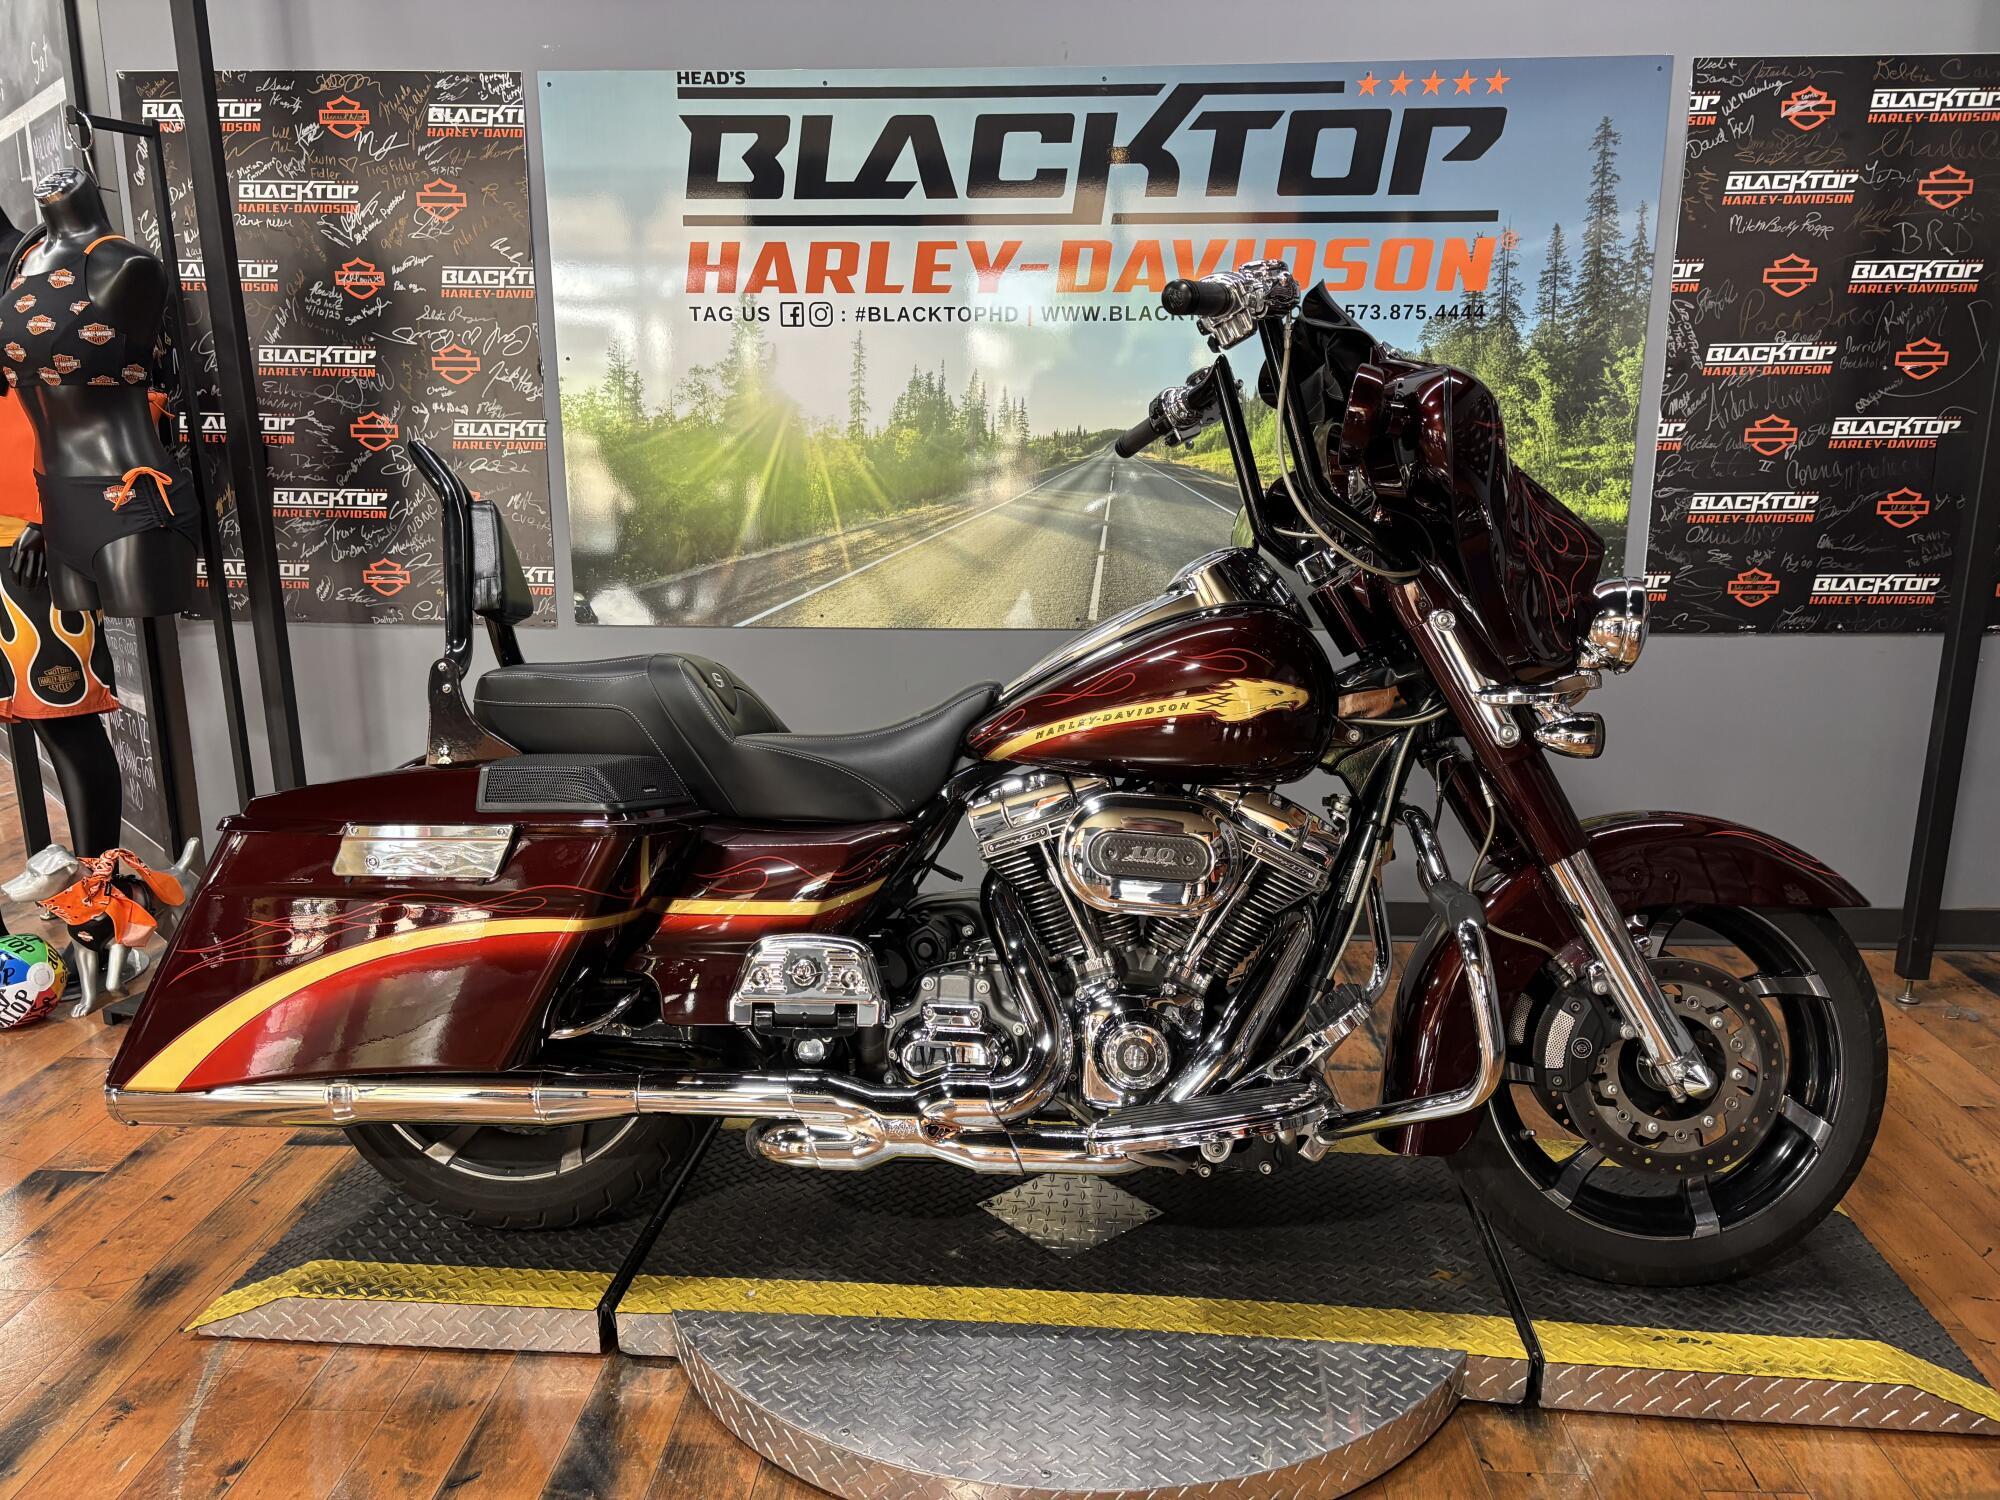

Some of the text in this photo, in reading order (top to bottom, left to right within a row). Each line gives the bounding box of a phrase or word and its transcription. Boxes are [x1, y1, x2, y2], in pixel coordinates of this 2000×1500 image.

[677, 71, 746, 85] HEAD'S
[1870, 90, 2000, 110] BLACKTOP
[142, 101, 262, 119] BLATOP
[428, 106, 524, 125] BLACKT
[679, 98, 1508, 213] BLACKTOP
[1725, 172, 1859, 192] BLACKTOP
[239, 182, 359, 201] BLACKTOP
[1722, 194, 1854, 206] HARLEY-DAVIDSON
[239, 203, 359, 214] HARLEY-DAVIDSON
[685, 236, 1498, 294] HARLEY-DAVIDSON
[1851, 262, 1984, 281] BLACKTOP
[441, 268, 535, 287] BLACKT
[1848, 283, 1978, 294] HARLEY-DAVIDSON
[689, 305, 770, 322] TAG US
[855, 305, 1018, 322] #BLACKTOPHD
[1345, 304, 1486, 321] 573.875.4444
[258, 347, 376, 365] BLACKTOP
[1706, 344, 1837, 363] BLACKTOP
[258, 366, 377, 377] HARLEY-DAVIDSON
[1702, 365, 1832, 377] HARLEY-DAVIDSON
[453, 421, 546, 439] BLACKT
[1831, 418, 1961, 436] BLACKTOP
[452, 440, 546, 450] HARLEY-DAVID
[1828, 439, 1937, 449] HARLEY-DAVIDS
[273, 490, 388, 508] BLACKTOP
[1690, 494, 1819, 512] BLACKTOP
[272, 508, 387, 519] HARLEY-DAVIDSON
[1687, 513, 1814, 524] HARLEY-DAVIDSON
[1812, 575, 1940, 594] BLACKTOP
[1809, 595, 1935, 605] HARLEY-DAVIDSON
[1034, 701, 1191, 741] HARLEY-DAVIDSON
